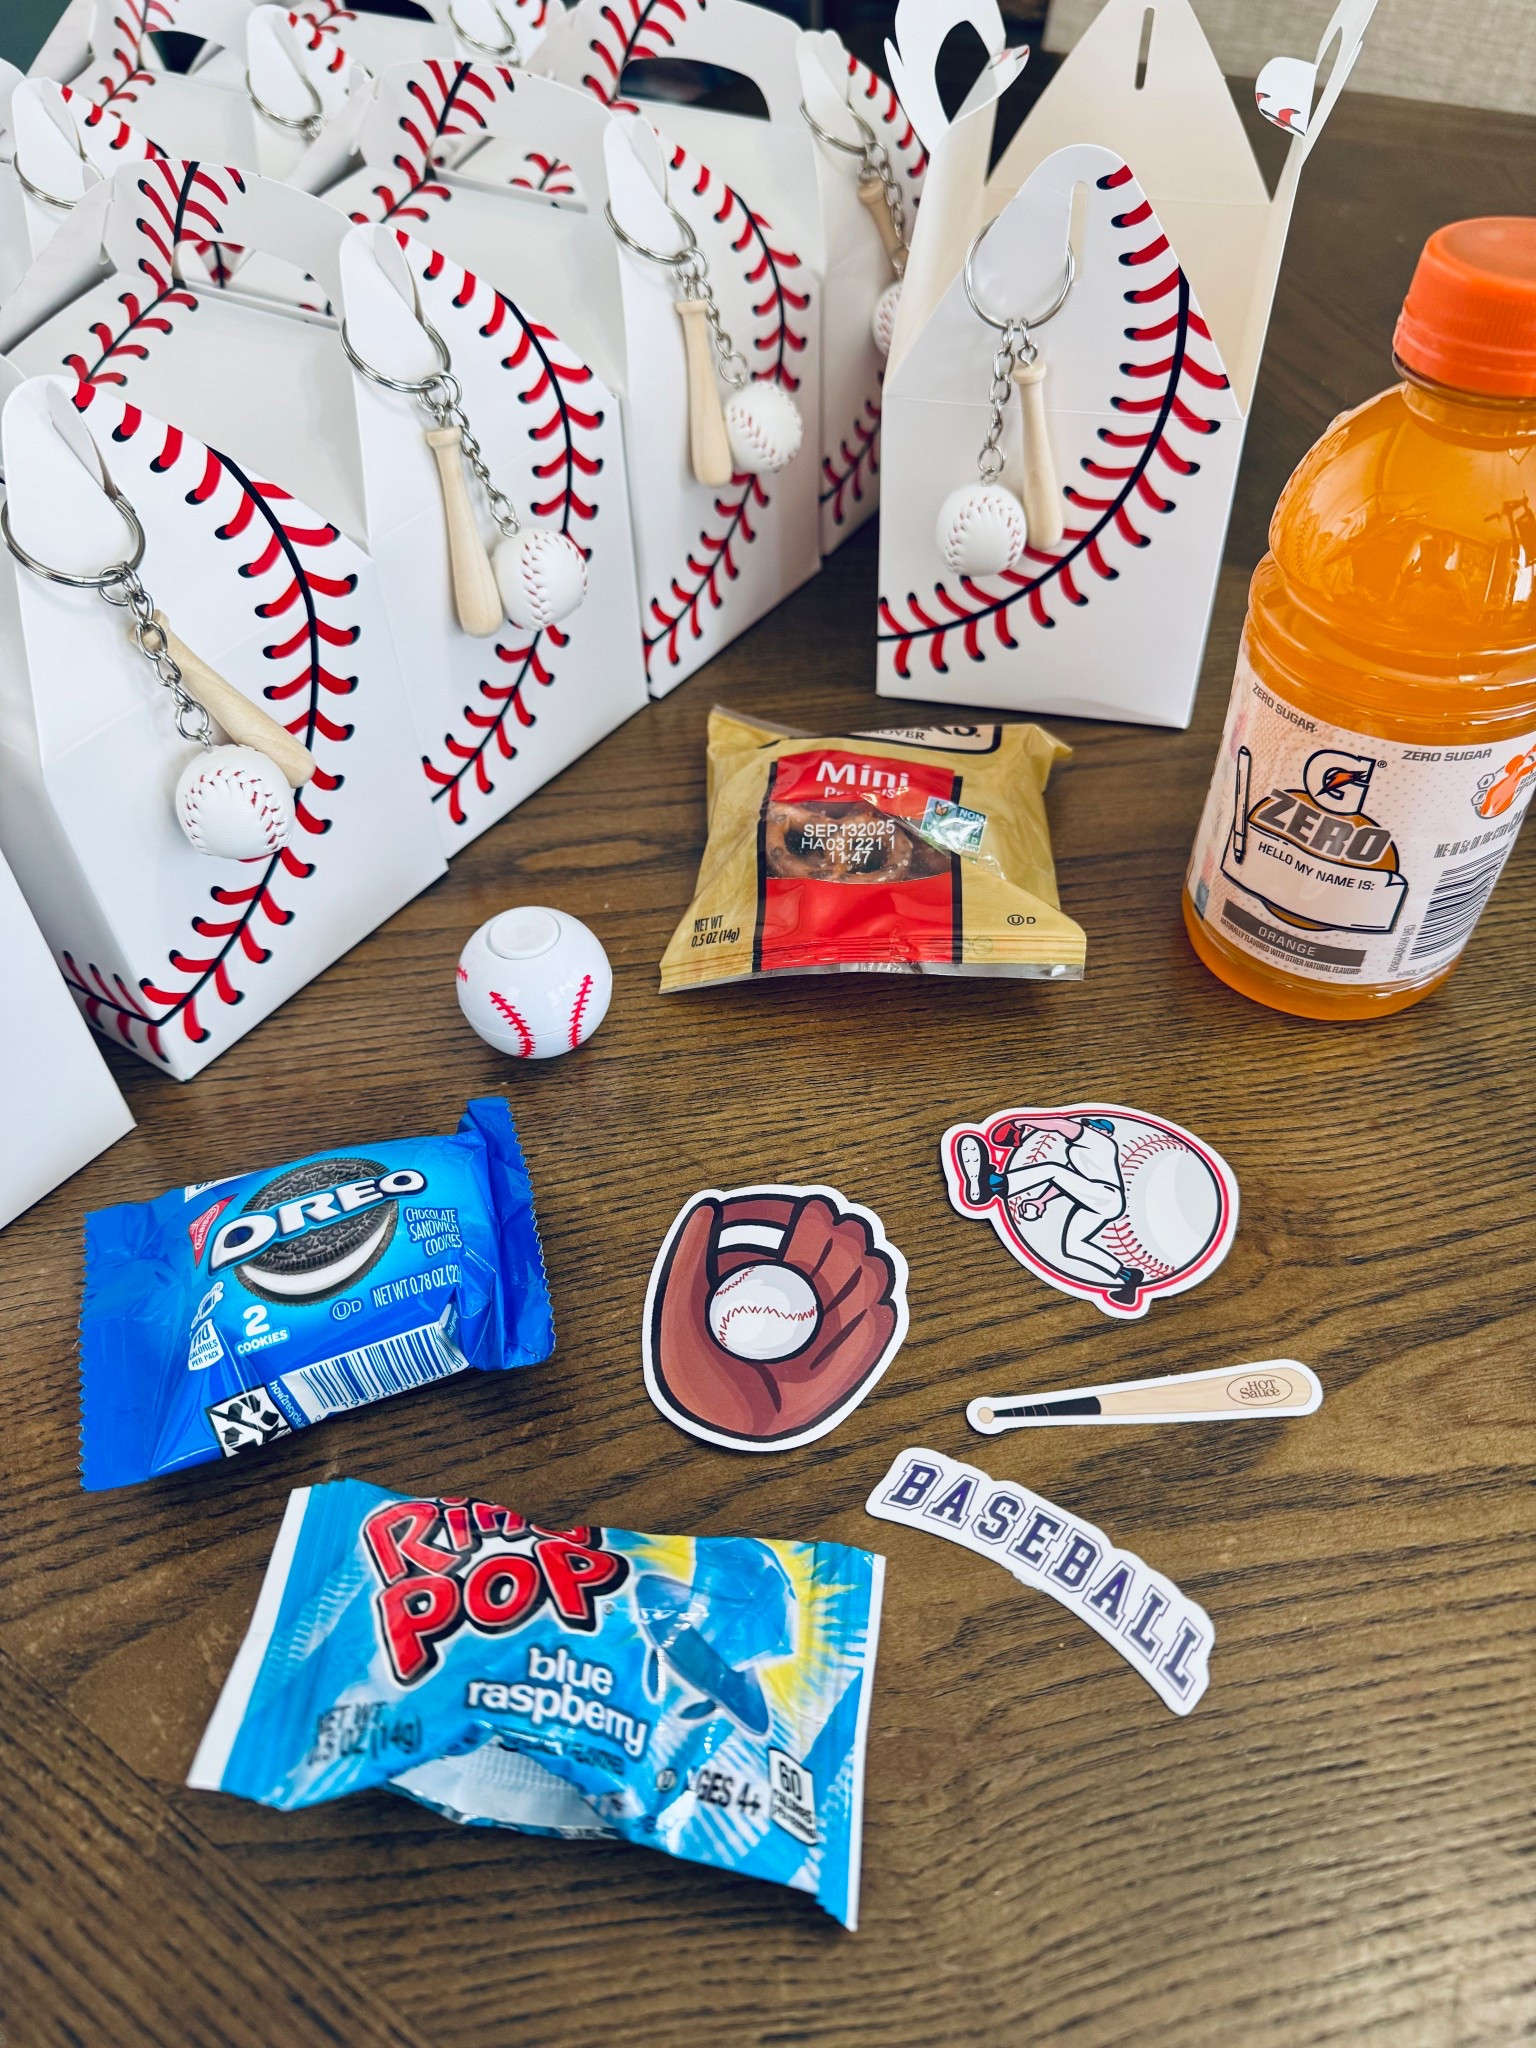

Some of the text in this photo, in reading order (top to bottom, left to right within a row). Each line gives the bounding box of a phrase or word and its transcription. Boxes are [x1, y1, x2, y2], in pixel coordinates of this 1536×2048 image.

[1252, 682, 1317, 733] ZERO SUGAR
[1401, 748, 1492, 762] ZERO SUGAR
[816, 760, 909, 788] Mini
[803, 820, 896, 837] SEP132025
[1256, 789, 1391, 864] ZERO
[829, 851, 871, 864] 11:47
[1258, 841, 1376, 891] HELLO MY NAME IS:
[691, 927, 740, 947] 0.5 OZ (14g)
[694, 915, 724, 933] NET WT
[1258, 926, 1317, 957] ORANGE
[1270, 947, 1285, 960] WITH
[1285, 954, 1304, 967] OTHER
[1304, 960, 1332, 973] NATURAL
[196, 1206, 218, 1246] NABISCO
[210, 1170, 426, 1270] OREO
[405, 1208, 456, 1224] CHOCOLATE
[409, 1219, 460, 1241] SANDWICH
[425, 1234, 462, 1256] COOKIES
[372, 1285, 393, 1308] NET
[392, 1279, 410, 1301] WT
[409, 1272, 432, 1295] 0.78
[431, 1267, 447, 1287] OZ
[243, 1304, 270, 1337] 2
[190, 1340, 219, 1360] CALORIES
[237, 1329, 289, 1354] COOKIES
[1240, 1387, 1281, 1399] Sauce
[1246, 1379, 1276, 1391] HOT
[881, 1458, 1205, 1701] BASEBALL
[380, 1539, 619, 1679] POP
[528, 1647, 614, 1696] blue
[467, 1681, 648, 1757] raspberry
[690, 1768, 734, 1807] GES
[779, 1760, 802, 1801] 60
